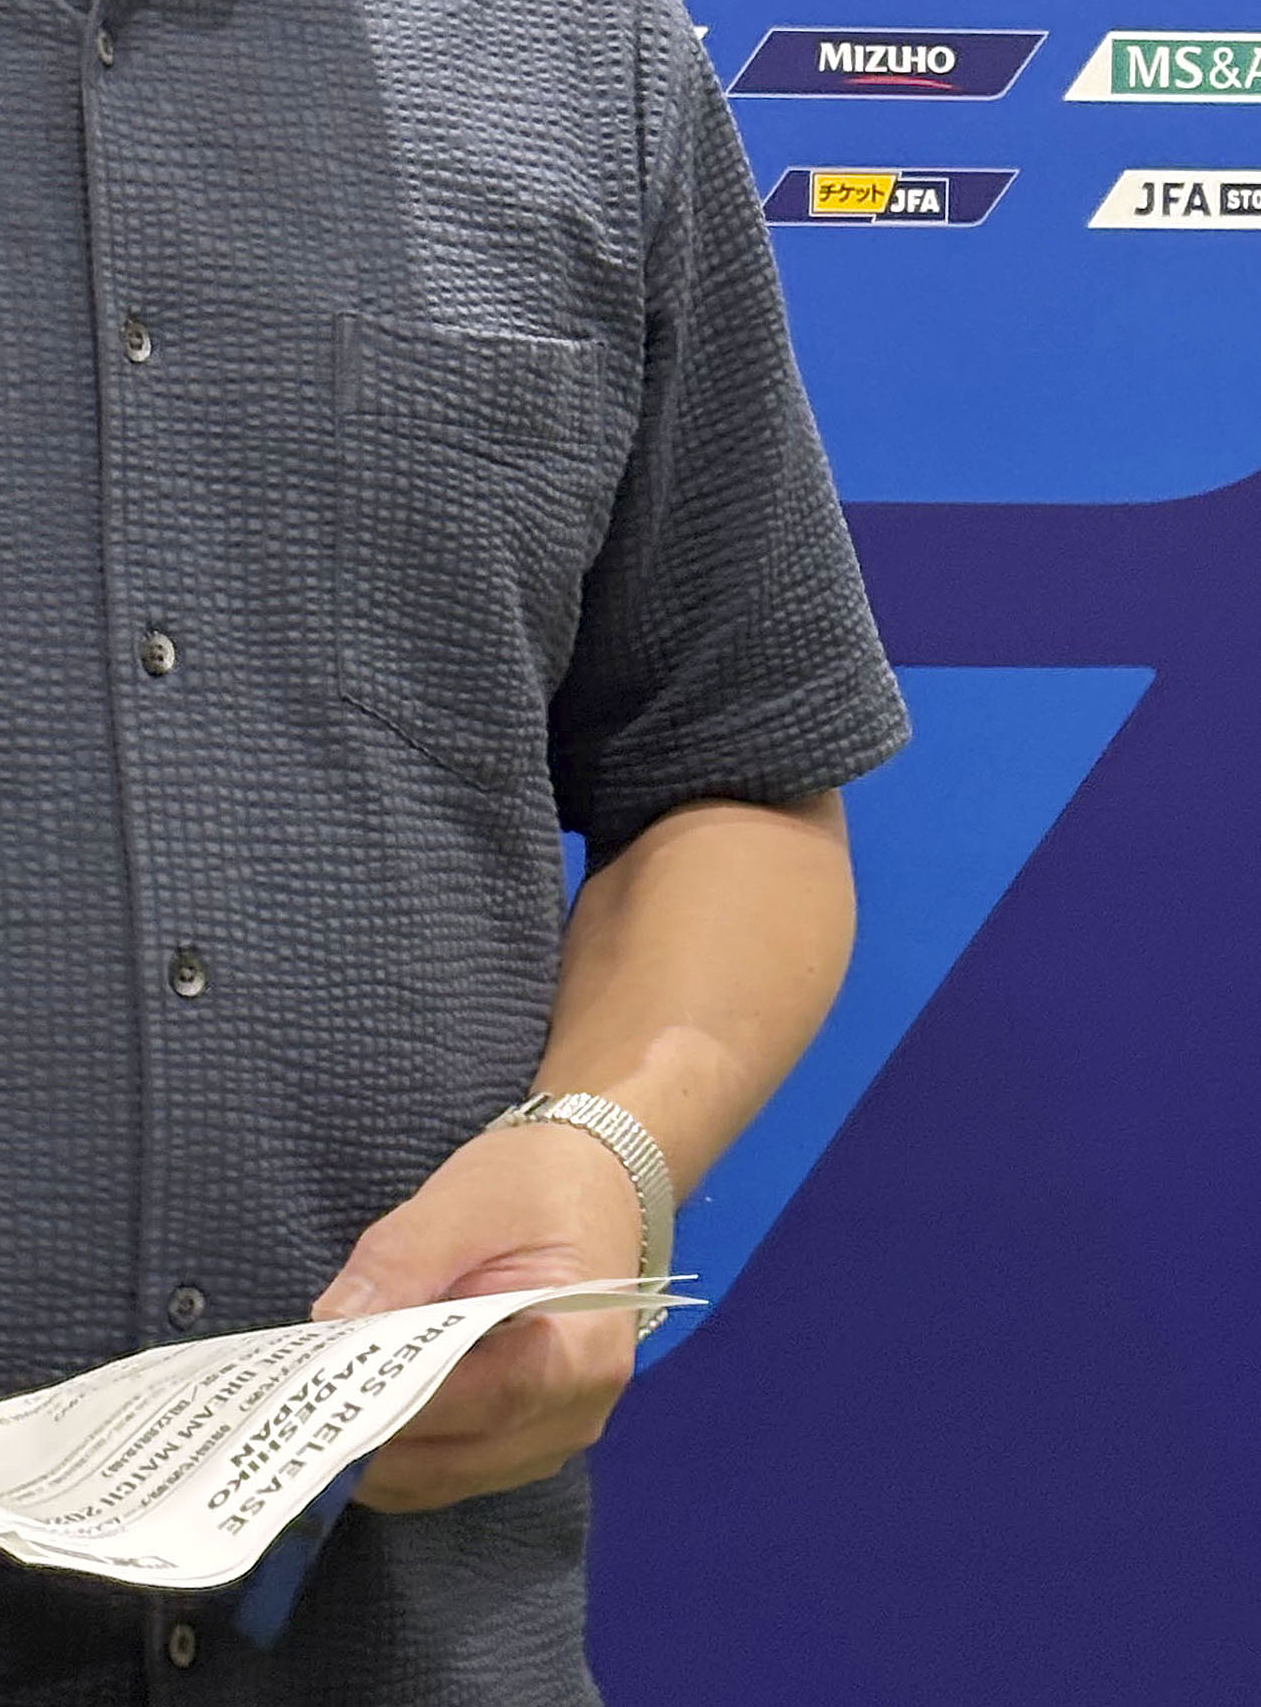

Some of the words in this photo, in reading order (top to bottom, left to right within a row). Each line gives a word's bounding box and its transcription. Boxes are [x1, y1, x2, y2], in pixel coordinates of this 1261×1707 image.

[818, 42, 956, 75] MIZUHO
[819, 183, 885, 203] チケット
[890, 189, 940, 213] JFA
[1134, 182, 1211, 216] JFA
[359, 1314, 466, 1397] PRESS
[177, 1369, 257, 1440] DREAM
[207, 1343, 381, 1510] NADESHIKO
[230, 1367, 326, 1468] JAPAN
[100, 1441, 180, 1508] MATCH
[218, 1401, 364, 1536] RELEASE
